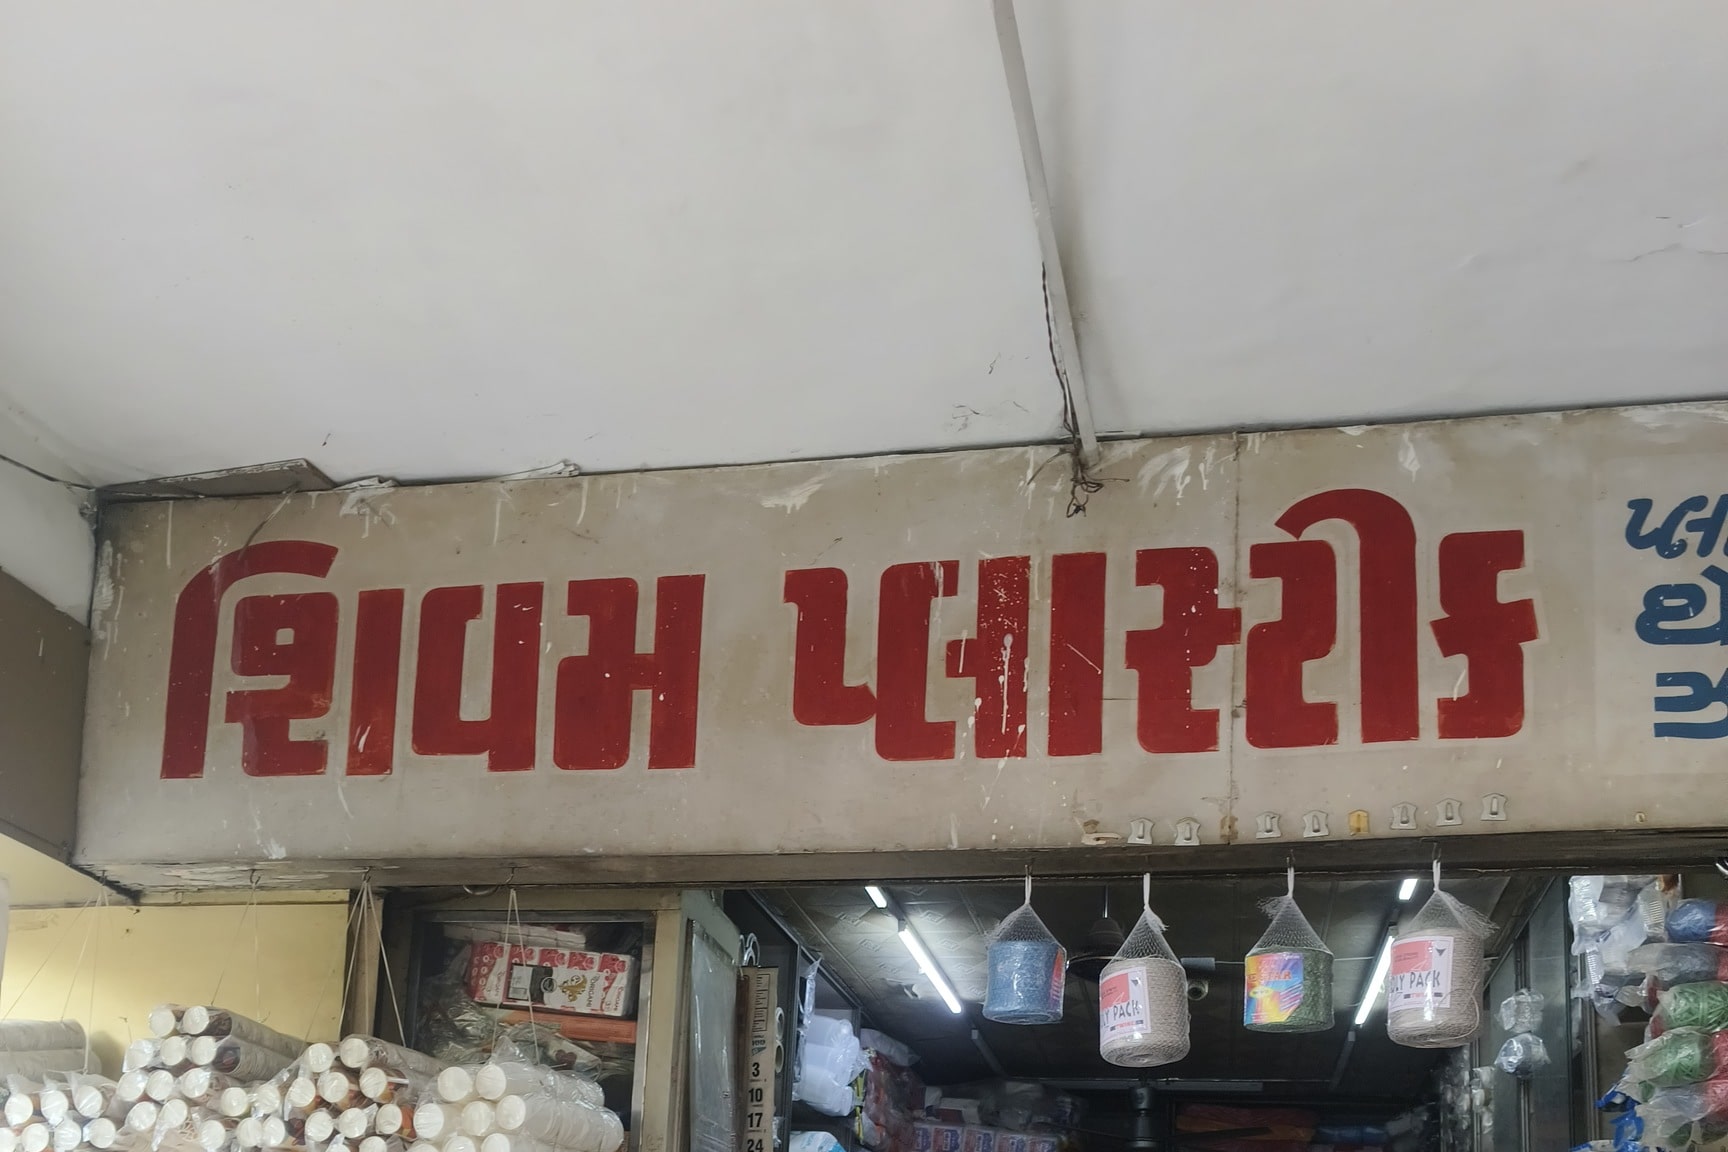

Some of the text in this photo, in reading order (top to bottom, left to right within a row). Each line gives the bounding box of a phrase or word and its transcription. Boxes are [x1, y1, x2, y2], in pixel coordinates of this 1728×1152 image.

[160, 487, 1539, 780] શિવમ પ્લાસ્ટીક
[1410, 969, 1441, 989] PACK
[1113, 999, 1140, 1020] PACK
[752, 1062, 760, 1077] 3
[748, 1088, 763, 1103] 10
[747, 1112, 763, 1128] 17
